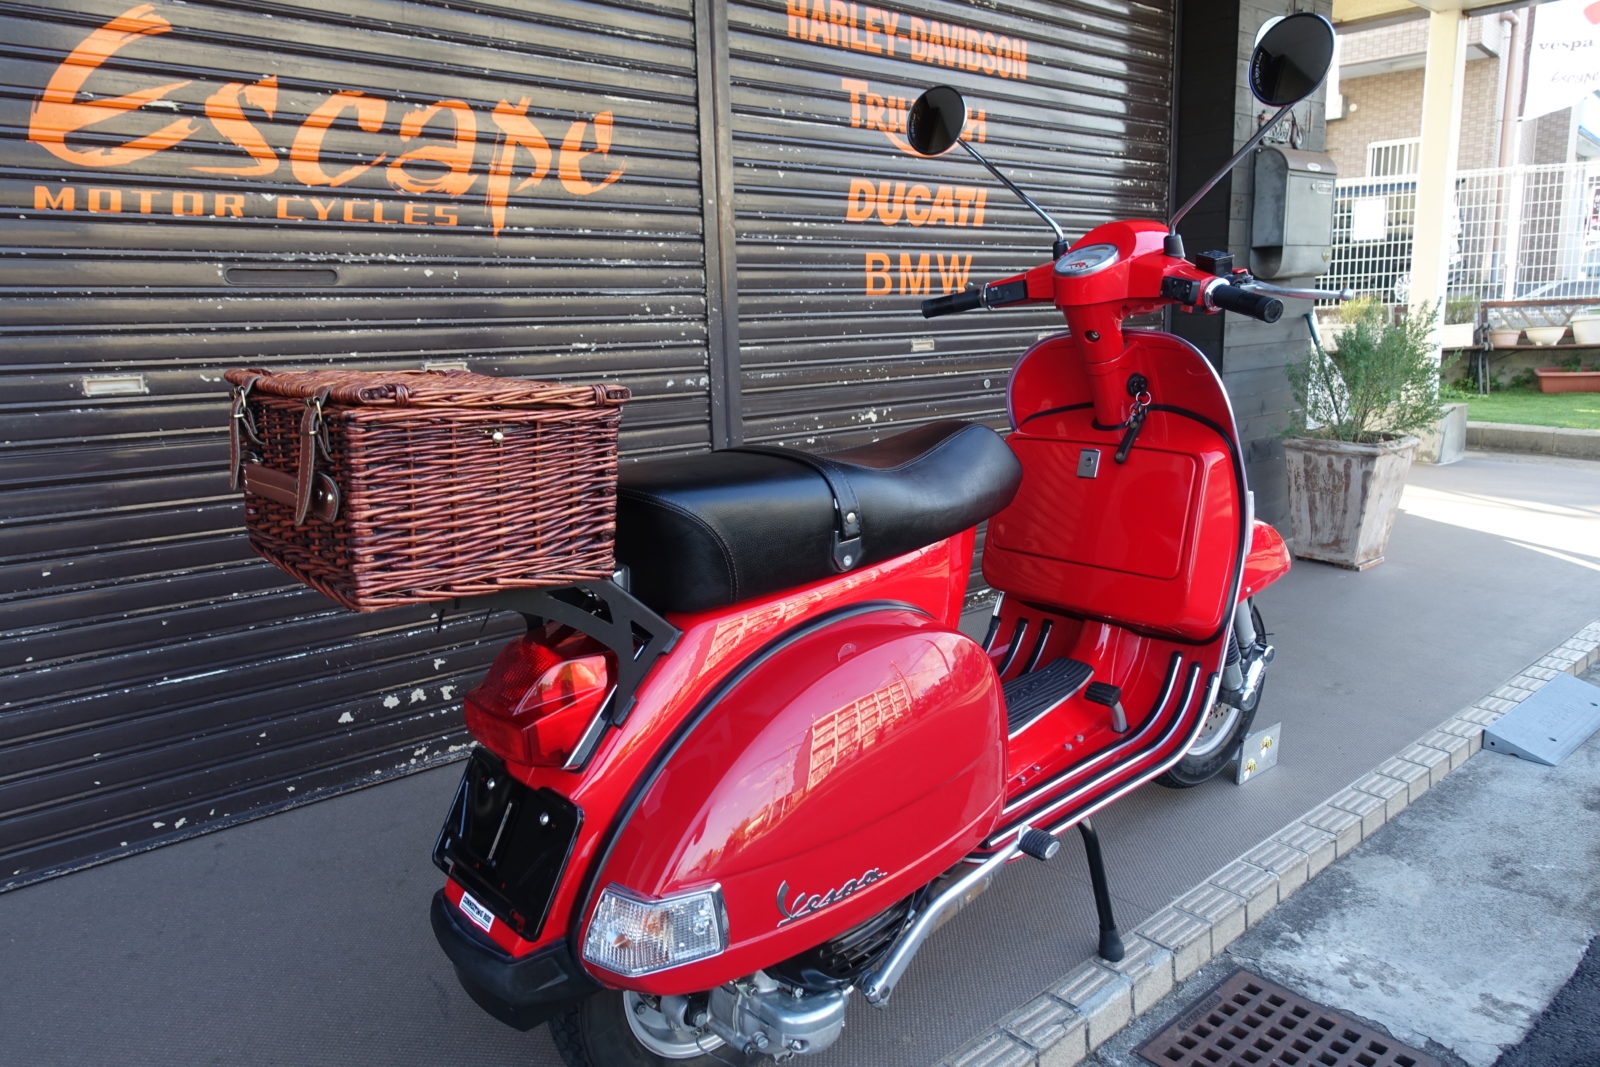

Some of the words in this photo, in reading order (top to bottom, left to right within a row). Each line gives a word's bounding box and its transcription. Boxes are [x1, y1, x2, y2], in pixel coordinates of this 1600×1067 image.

[786, 0, 1029, 80] HARLEY-DAVIDSON
[27, 4, 627, 237] Escape
[841, 78, 986, 143] TRIUH
[34, 185, 244, 217] MOTOR
[276, 197, 459, 227] CYCLES
[846, 178, 987, 227] DUCATI
[865, 252, 974, 296] BMW
[777, 867, 888, 928] Vespa
